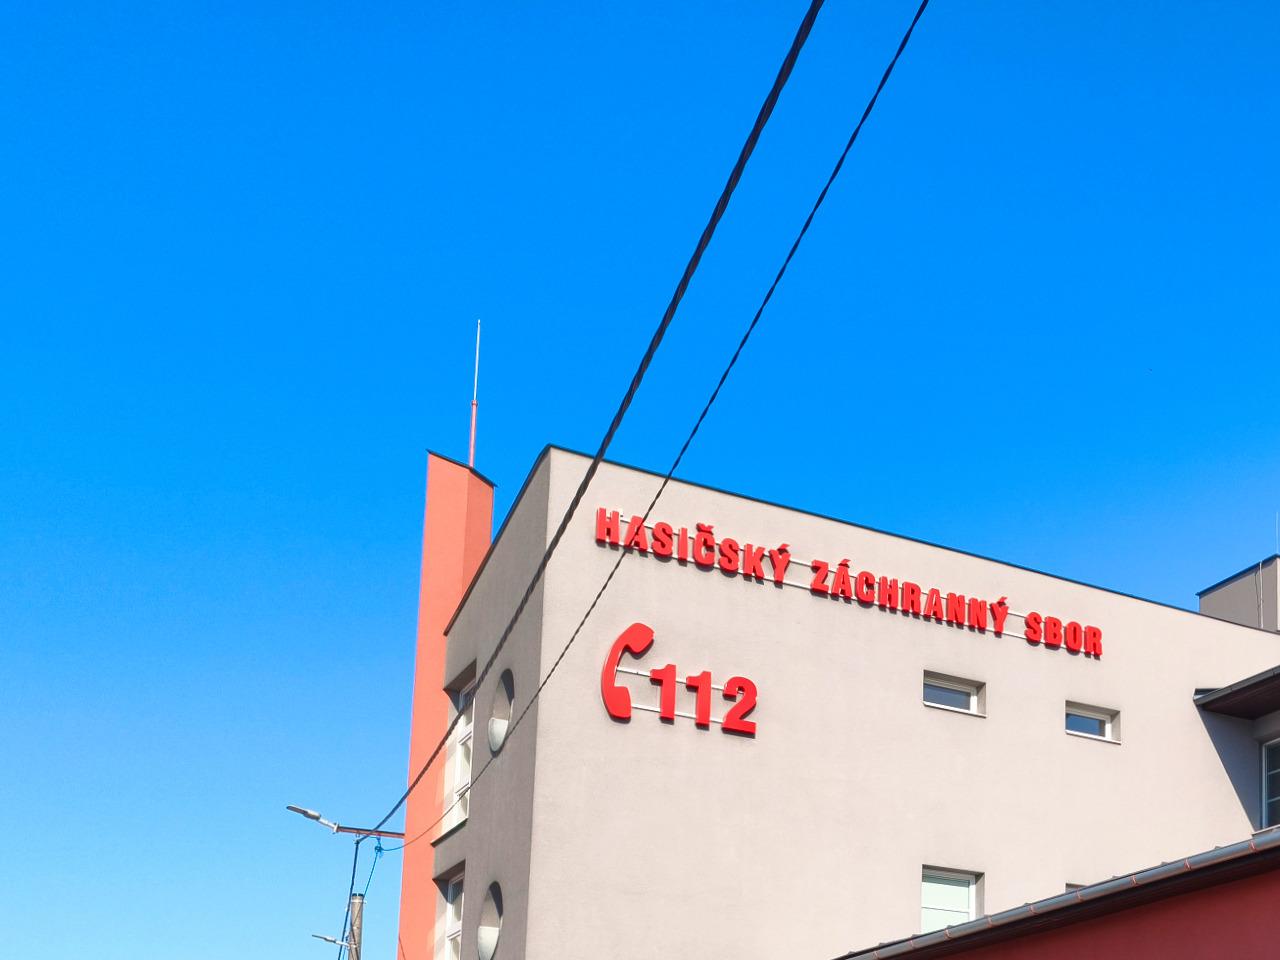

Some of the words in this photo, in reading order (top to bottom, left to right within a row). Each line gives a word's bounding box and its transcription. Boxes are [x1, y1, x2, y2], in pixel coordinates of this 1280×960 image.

[596, 507, 791, 583] HASIČSKÝ
[810, 559, 1008, 638] ZÁCHRANNÝ
[1024, 612, 1103, 656] SBOR
[650, 664, 757, 734] 112
